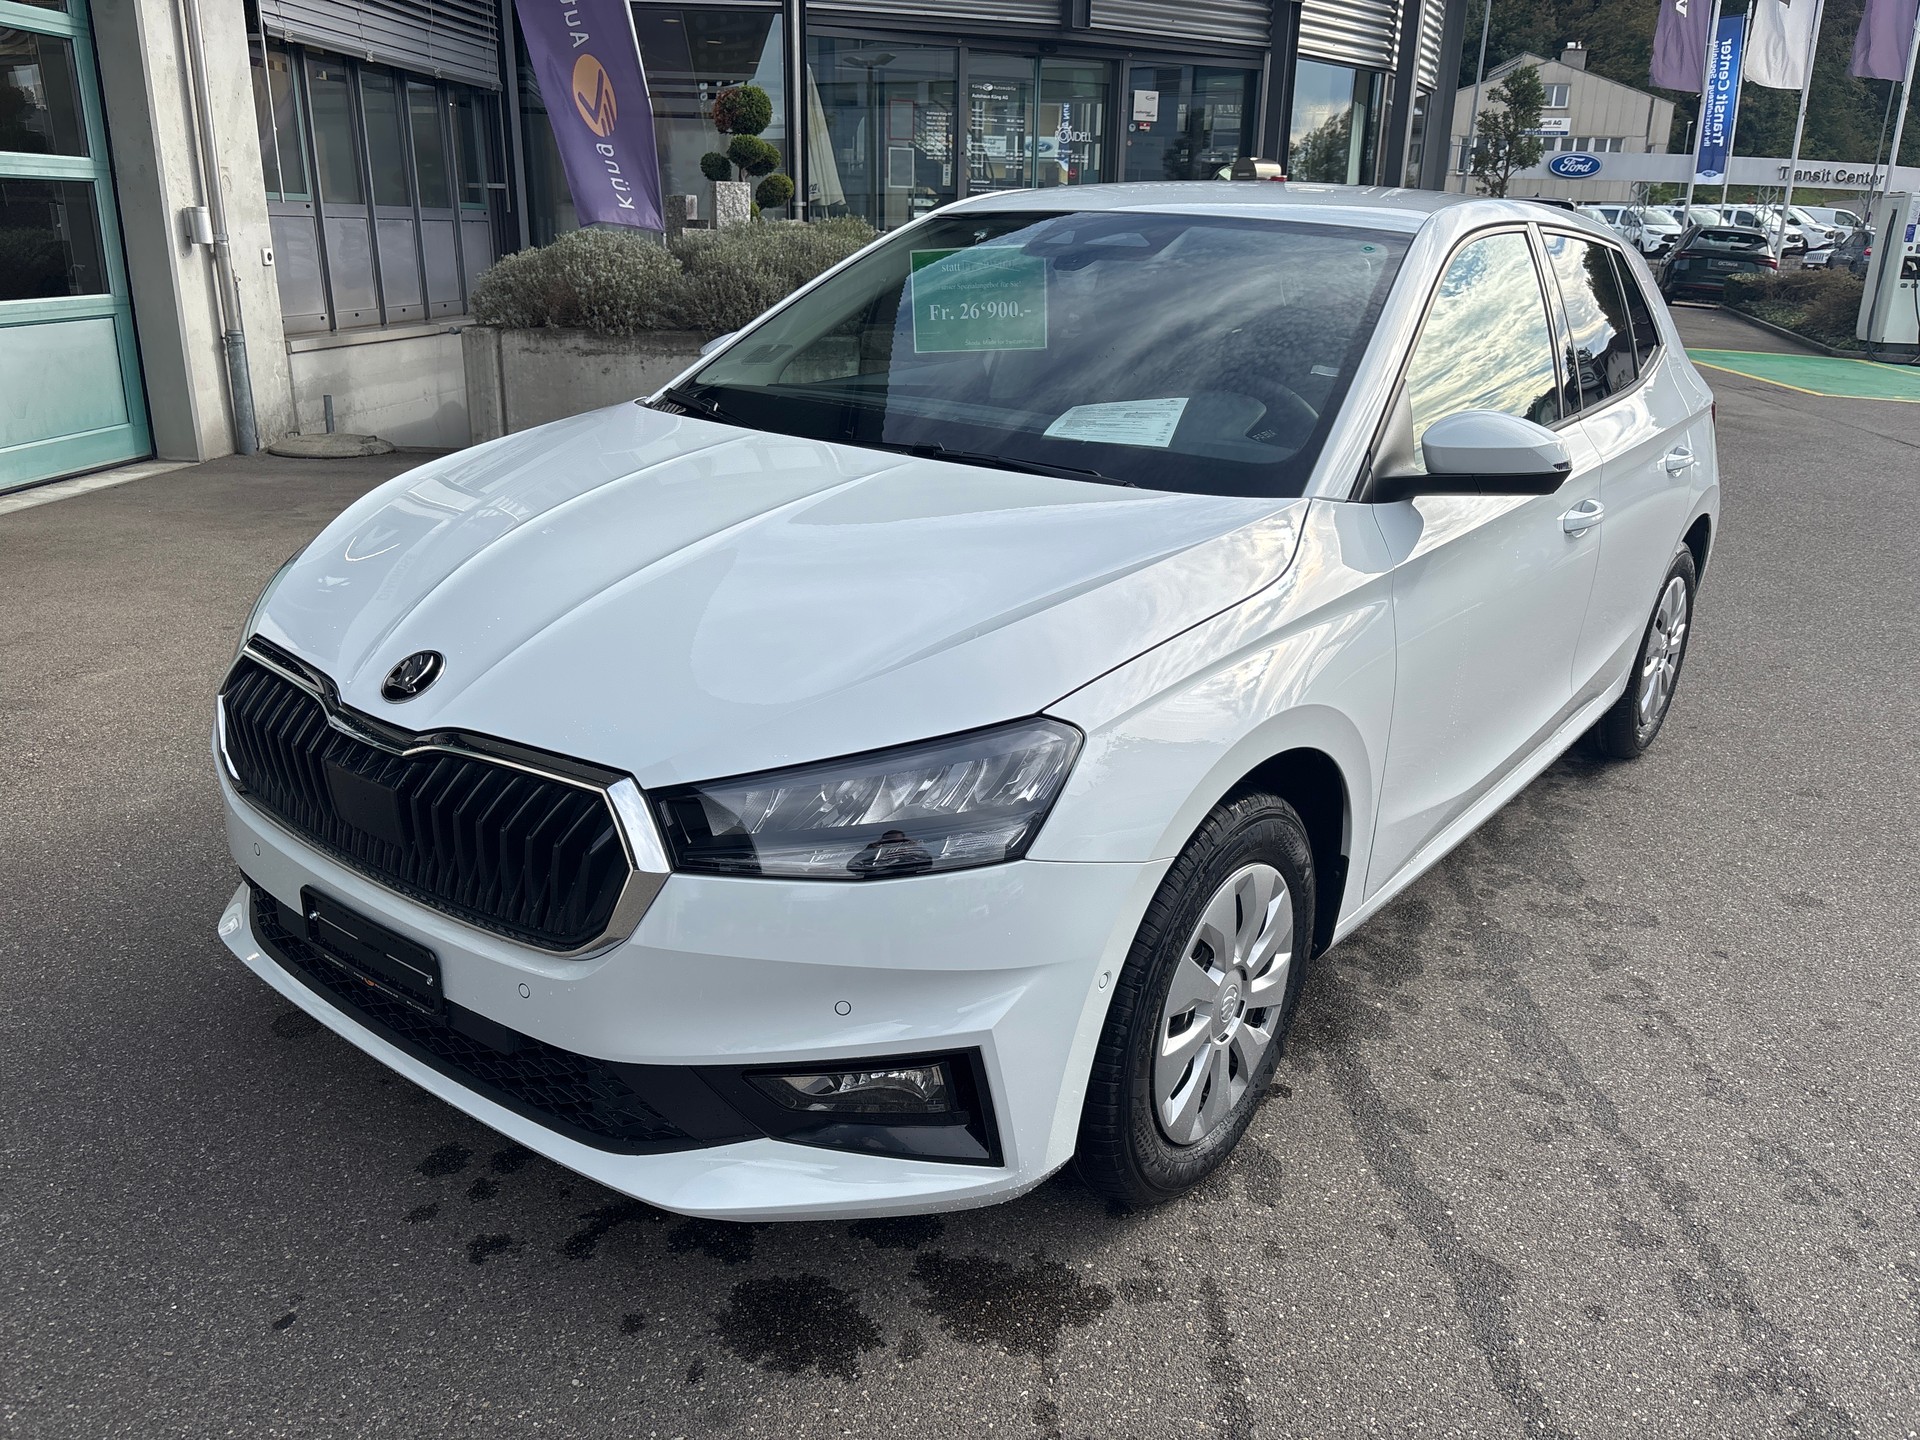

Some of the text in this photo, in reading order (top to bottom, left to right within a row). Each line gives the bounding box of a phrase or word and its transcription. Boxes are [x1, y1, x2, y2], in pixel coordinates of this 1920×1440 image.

[1559, 156, 1593, 173] Ford
[1778, 166, 1886, 185] Tansit Center
[941, 262, 961, 273] statt
[929, 304, 955, 321] Fr.
